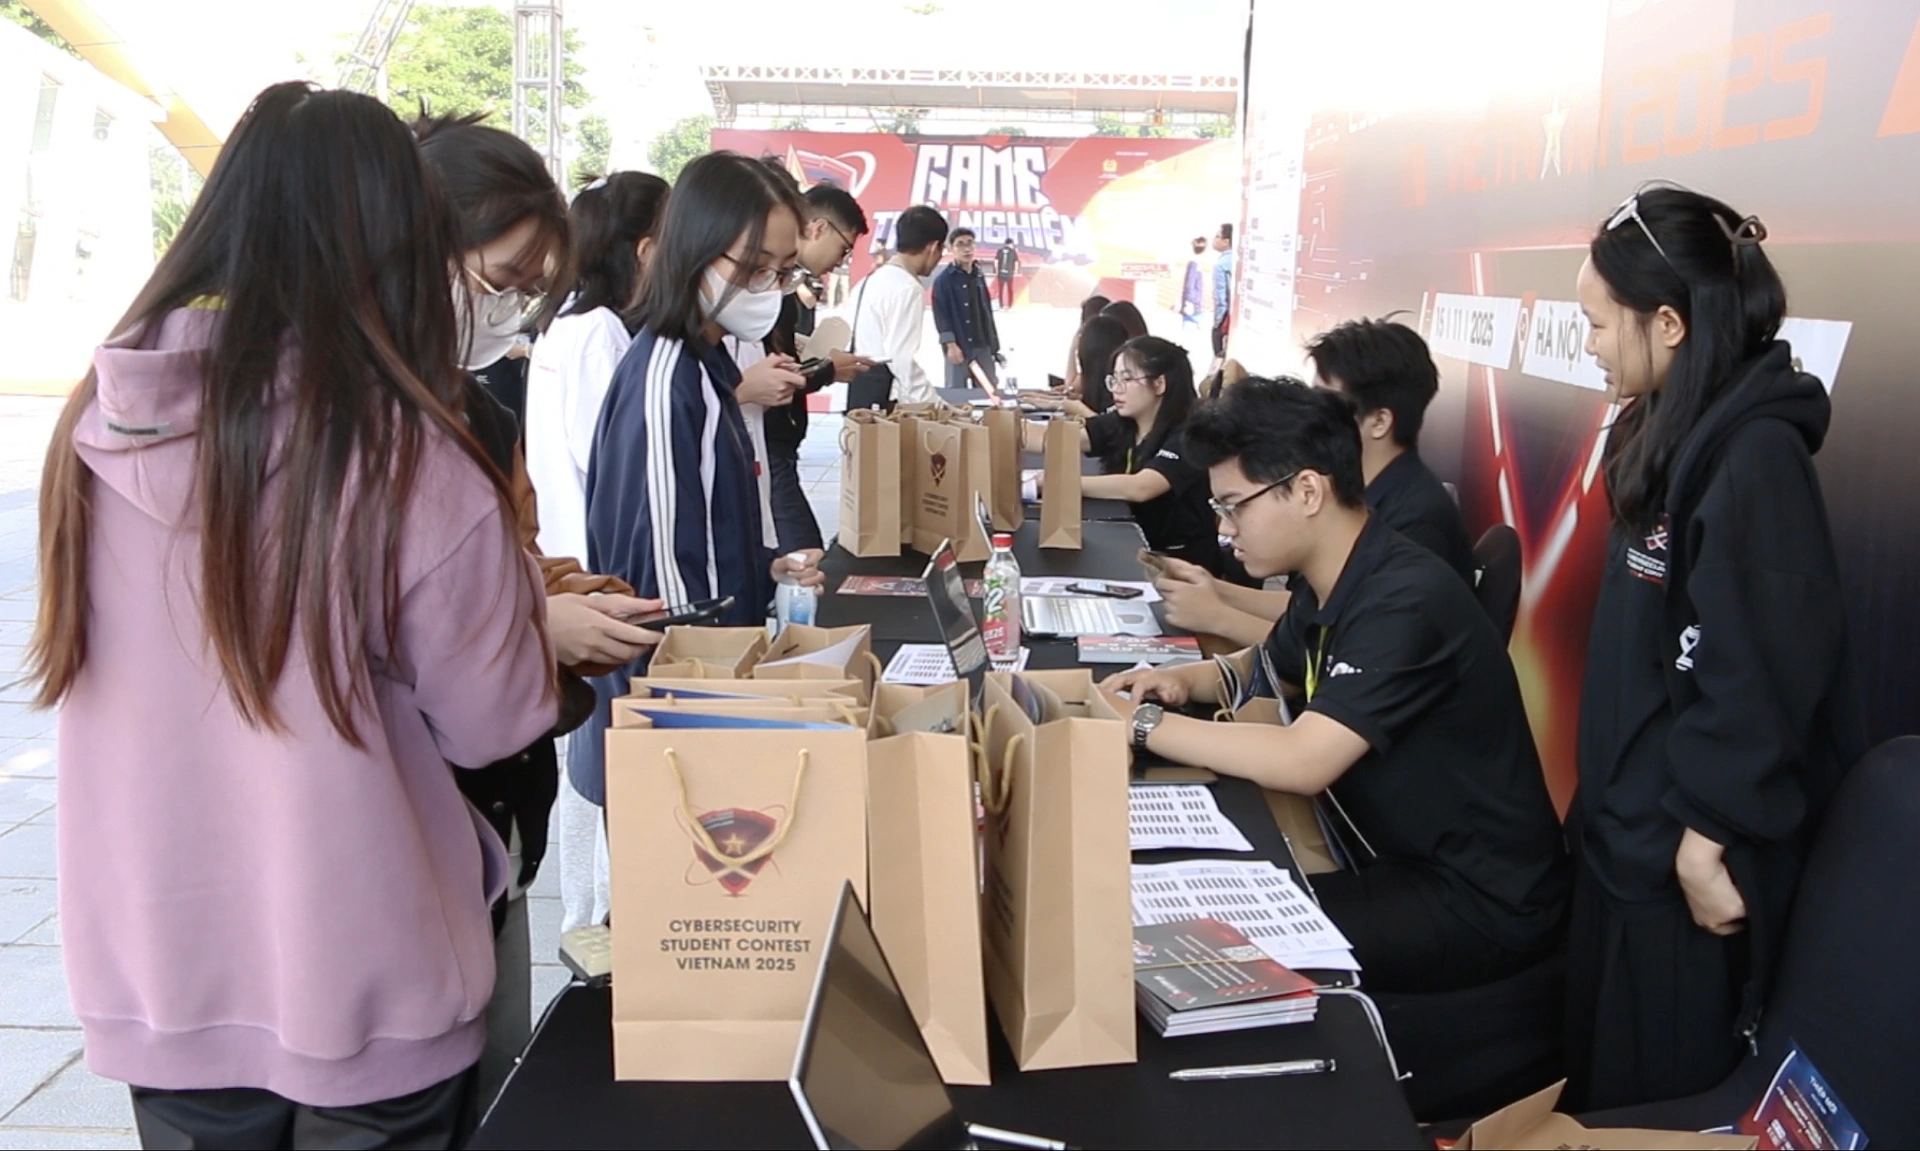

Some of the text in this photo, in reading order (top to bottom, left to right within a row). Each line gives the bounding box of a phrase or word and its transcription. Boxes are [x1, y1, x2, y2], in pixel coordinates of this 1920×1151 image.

[1621, 12, 1832, 164] 2025
[909, 144, 1051, 208] GAME
[669, 919, 802, 933] CYBERSECURITY
[660, 938, 811, 953] STUDENT CONTEST
[677, 956, 796, 971] VIETNAM 2025
